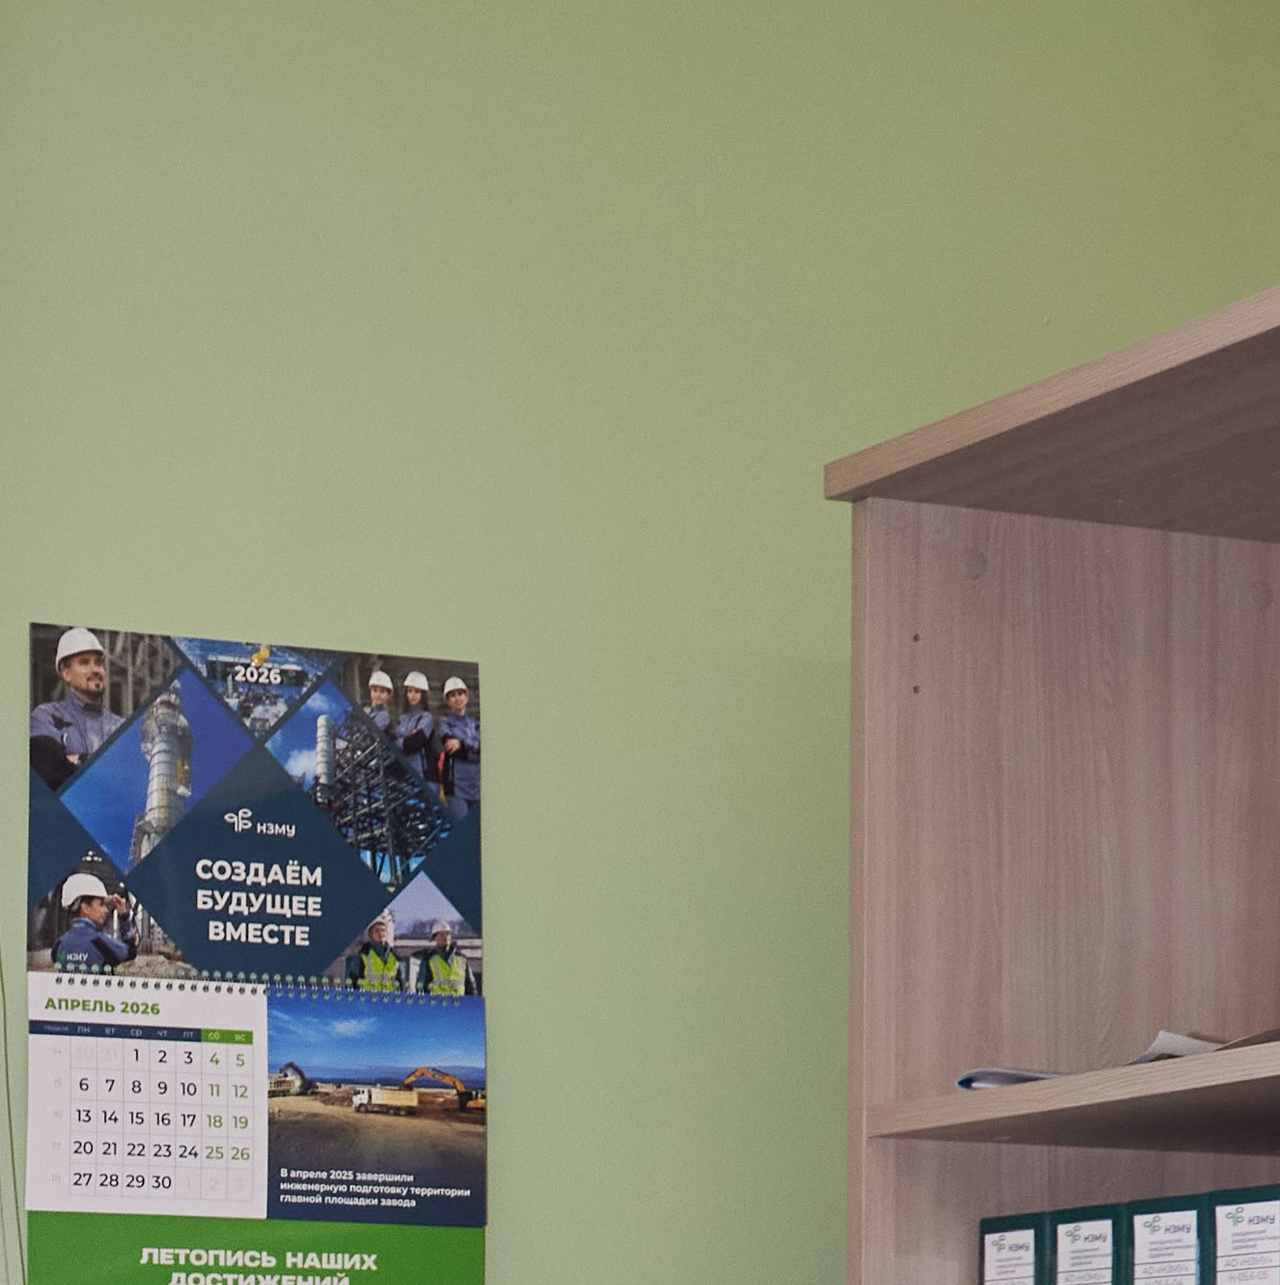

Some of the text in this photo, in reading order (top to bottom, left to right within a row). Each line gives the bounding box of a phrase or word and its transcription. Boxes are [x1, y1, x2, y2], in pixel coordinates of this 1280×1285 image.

[234, 665, 281, 685] 2026
[257, 823, 295, 837] НЗМУ
[196, 858, 322, 888] СОЗДАЁМ
[197, 890, 322, 919] БУДУЩЕЕ
[209, 922, 309, 947] ВМЕСТЕ
[45, 998, 160, 1016] АПРЕЛЬ 2026
[133, 1049, 140, 1062] 1
[158, 1050, 167, 1063] 2
[183, 1051, 193, 1065] 3
[209, 1053, 220, 1066] 4
[236, 1054, 245, 1067] 5
[79, 1078, 248, 1098] 6 7 8 9 10 11 12
[76, 1109, 92, 1123] 13
[102, 1110, 118, 1124] 14
[128, 1111, 144, 1125] 15
[154, 1112, 171, 1126] 16
[181, 1114, 196, 1127] 17
[207, 1115, 223, 1128] 18
[233, 1116, 249, 1129] 19
[73, 1141, 93, 1155] 20
[102, 1142, 117, 1156] 21
[127, 1143, 146, 1157] 22
[153, 1144, 172, 1158] 23
[179, 1145, 199, 1159] 24
[205, 1146, 224, 1160] 25
[231, 1147, 250, 1161] 26
[73, 1173, 92, 1186] 27
[99, 1174, 119, 1187] 28
[126, 1175, 145, 1188] 29
[152, 1175, 172, 1189] 30
[280, 1168, 413, 1182] В апреле 2025 завершили
[280, 1182, 471, 1198] инженерную подготовку территории
[280, 1194, 416, 1209] главной площадки завода
[140, 1247, 378, 1271] ЛЕТОПИСЬ НАШИХ
